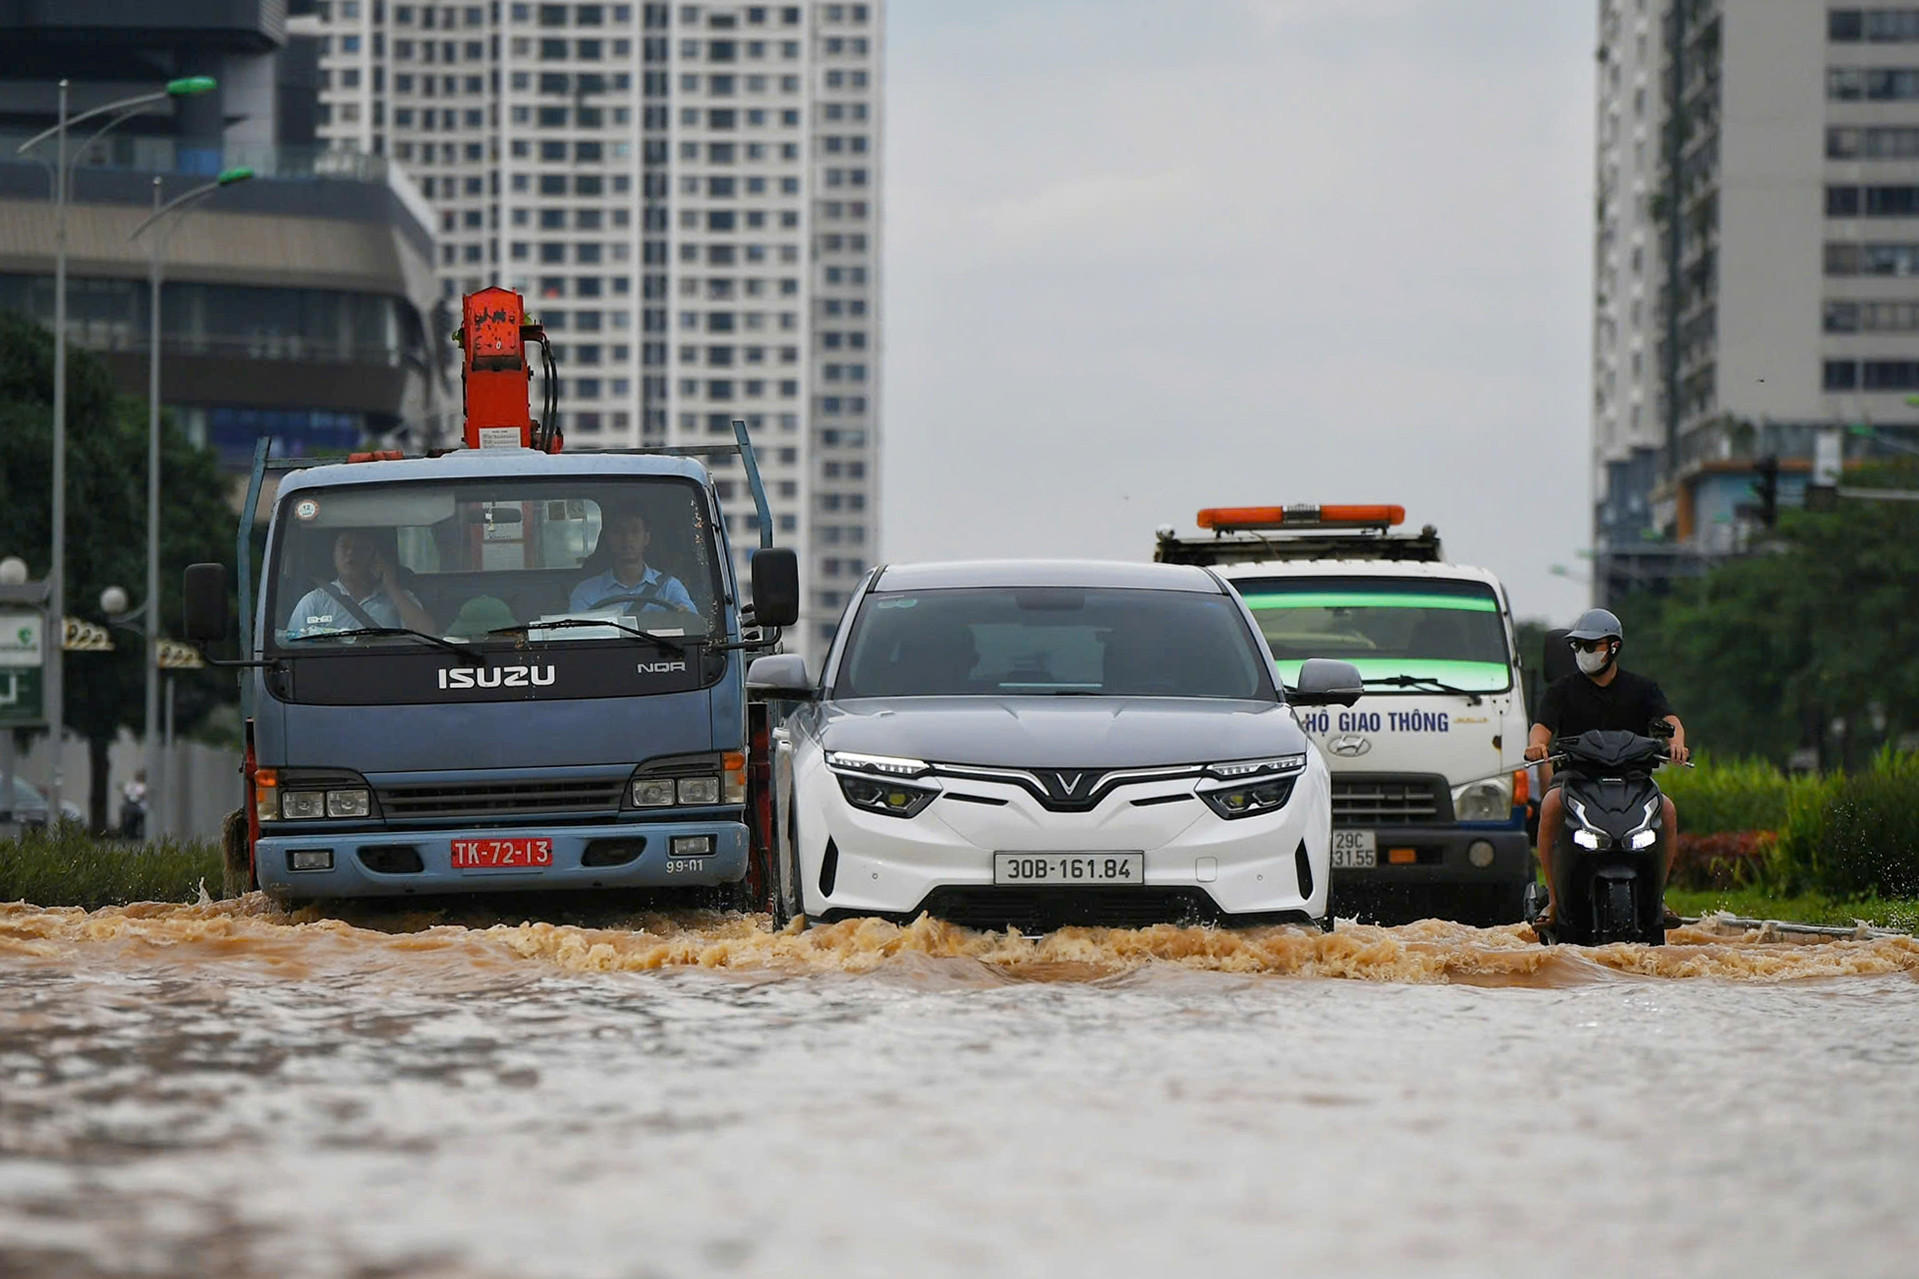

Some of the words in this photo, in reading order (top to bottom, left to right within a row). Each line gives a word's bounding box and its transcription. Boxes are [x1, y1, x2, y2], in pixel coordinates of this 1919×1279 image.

[438, 665, 556, 689] ISUZU
[637, 661, 686, 673] NQR
[1305, 710, 1329, 737] HỘ
[1339, 712, 1381, 732] GIAO
[1388, 709, 1449, 732] THÔNG
[1336, 833, 1363, 849] 29C
[455, 841, 548, 864] TK-72-13
[1331, 850, 1375, 866] 31.55
[1007, 859, 1131, 879] 30B-161.84
